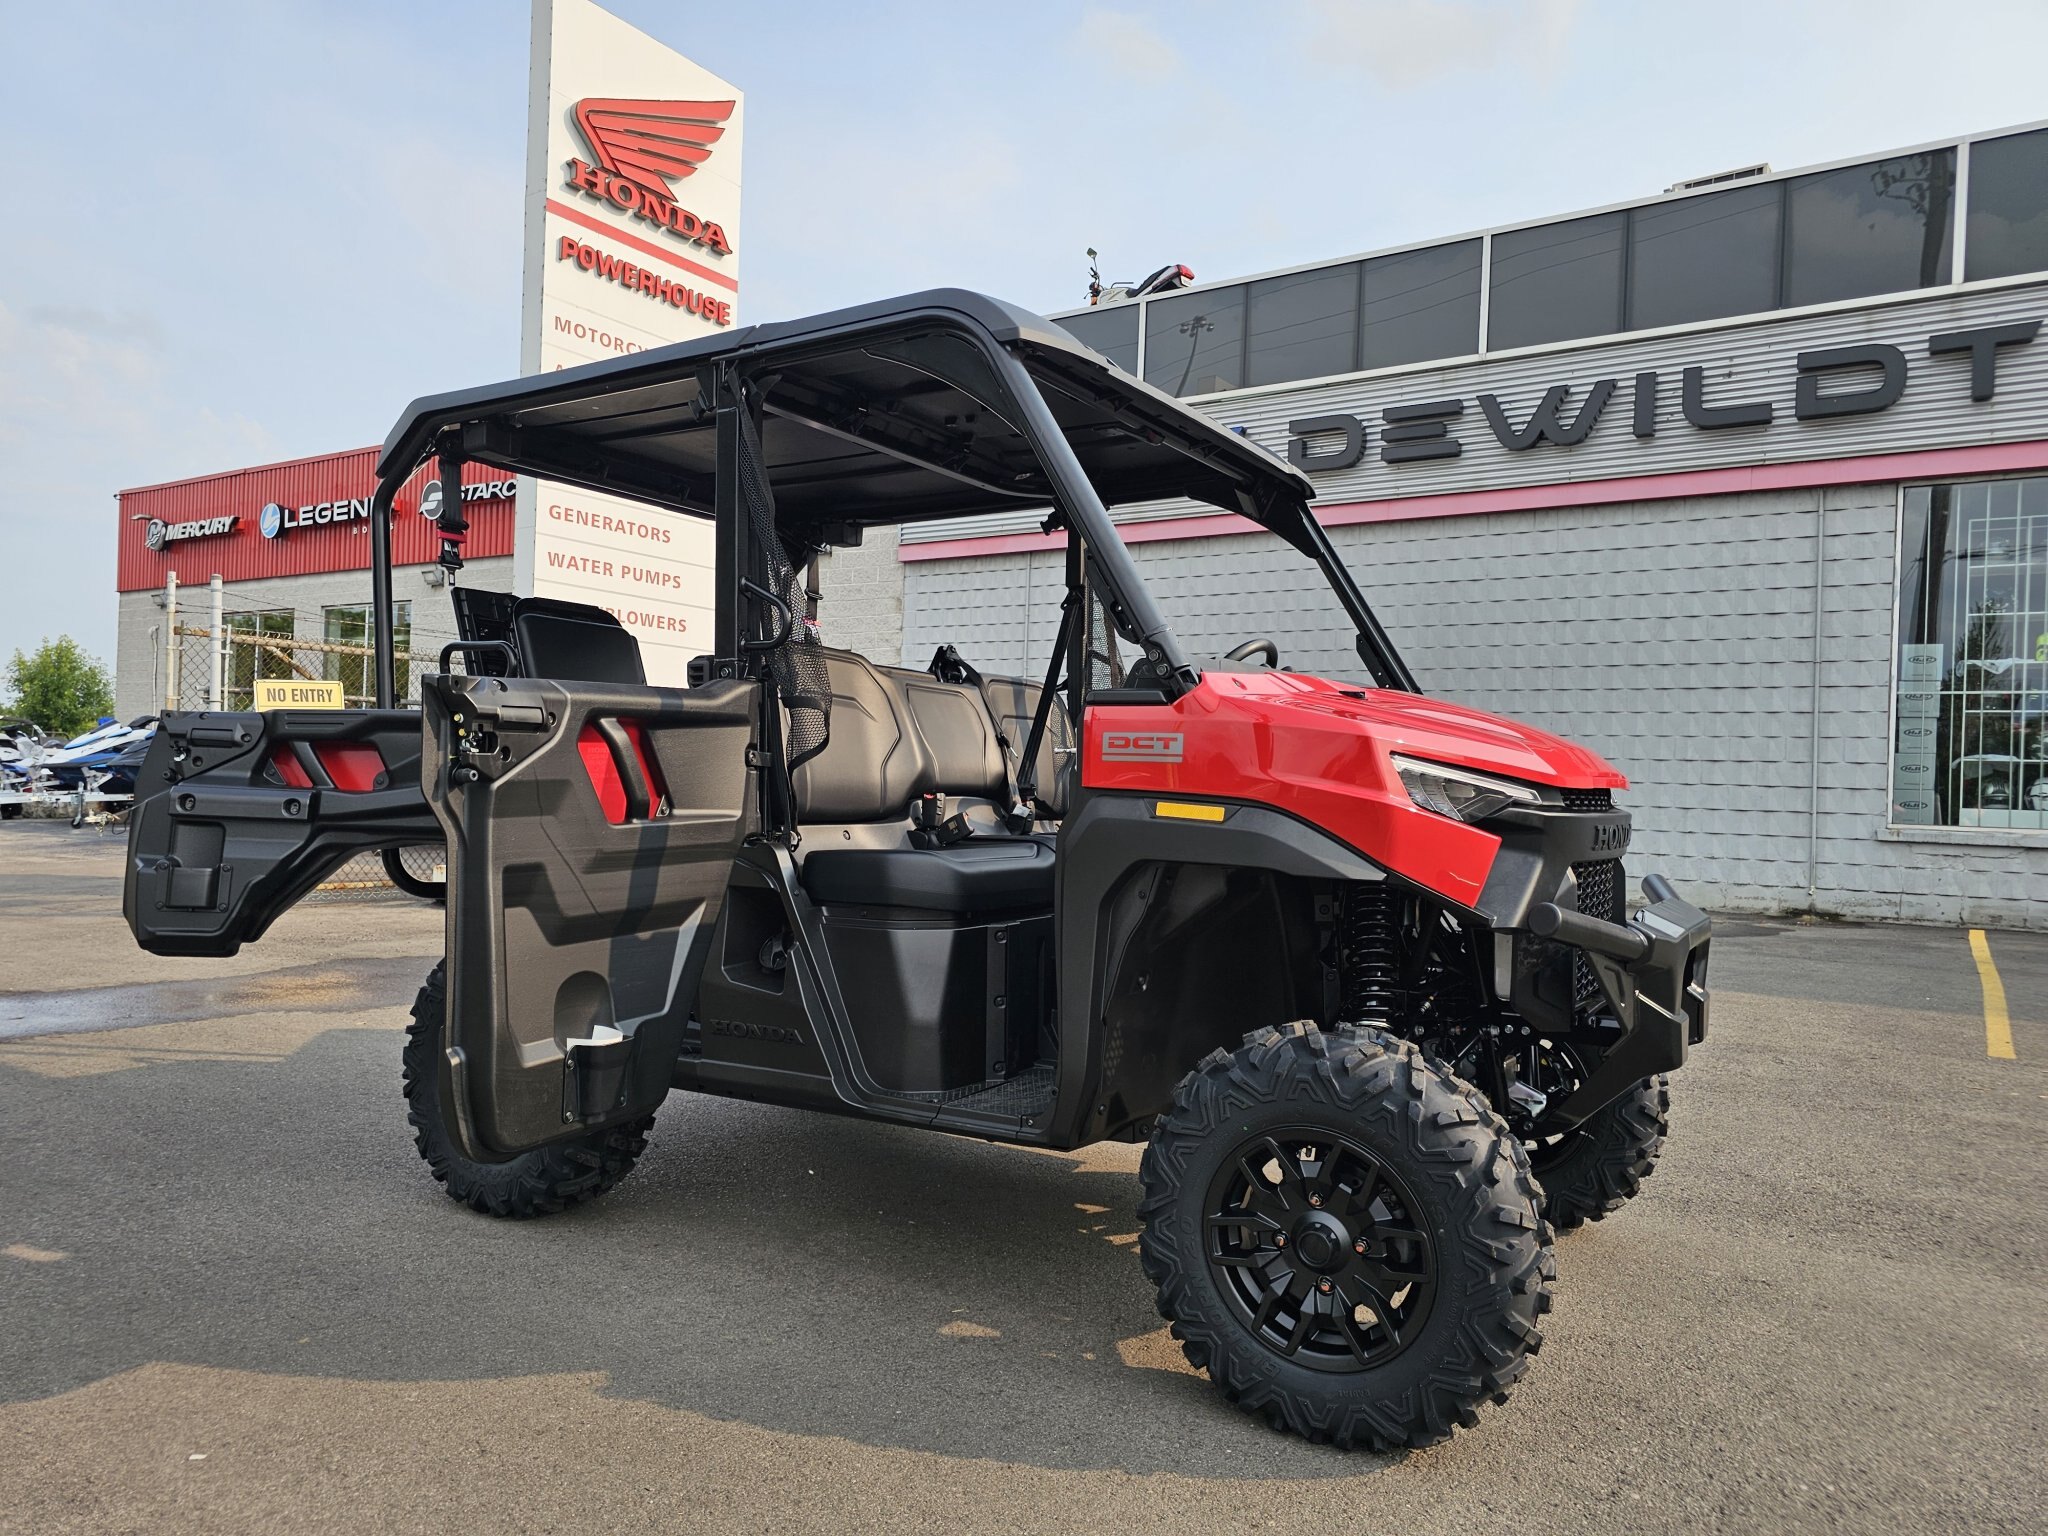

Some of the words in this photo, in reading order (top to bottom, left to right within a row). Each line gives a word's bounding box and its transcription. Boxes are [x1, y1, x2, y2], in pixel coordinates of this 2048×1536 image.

[567, 157, 732, 255] HONDA
[559, 235, 731, 326] POWERHOUSE
[1287, 320, 2044, 473] DEWILDT
[284, 496, 394, 528] LEGEN
[549, 504, 671, 544] GENERATORS
[165, 516, 236, 541] MERCURY
[547, 551, 613, 577] WATER
[621, 565, 681, 589] PUMPS
[600, 606, 687, 632] LOWERS
[266, 688, 286, 702] NO
[291, 688, 333, 703] ENTRY
[1108, 736, 1178, 750] DCT
[710, 1018, 806, 1046] HONDA
